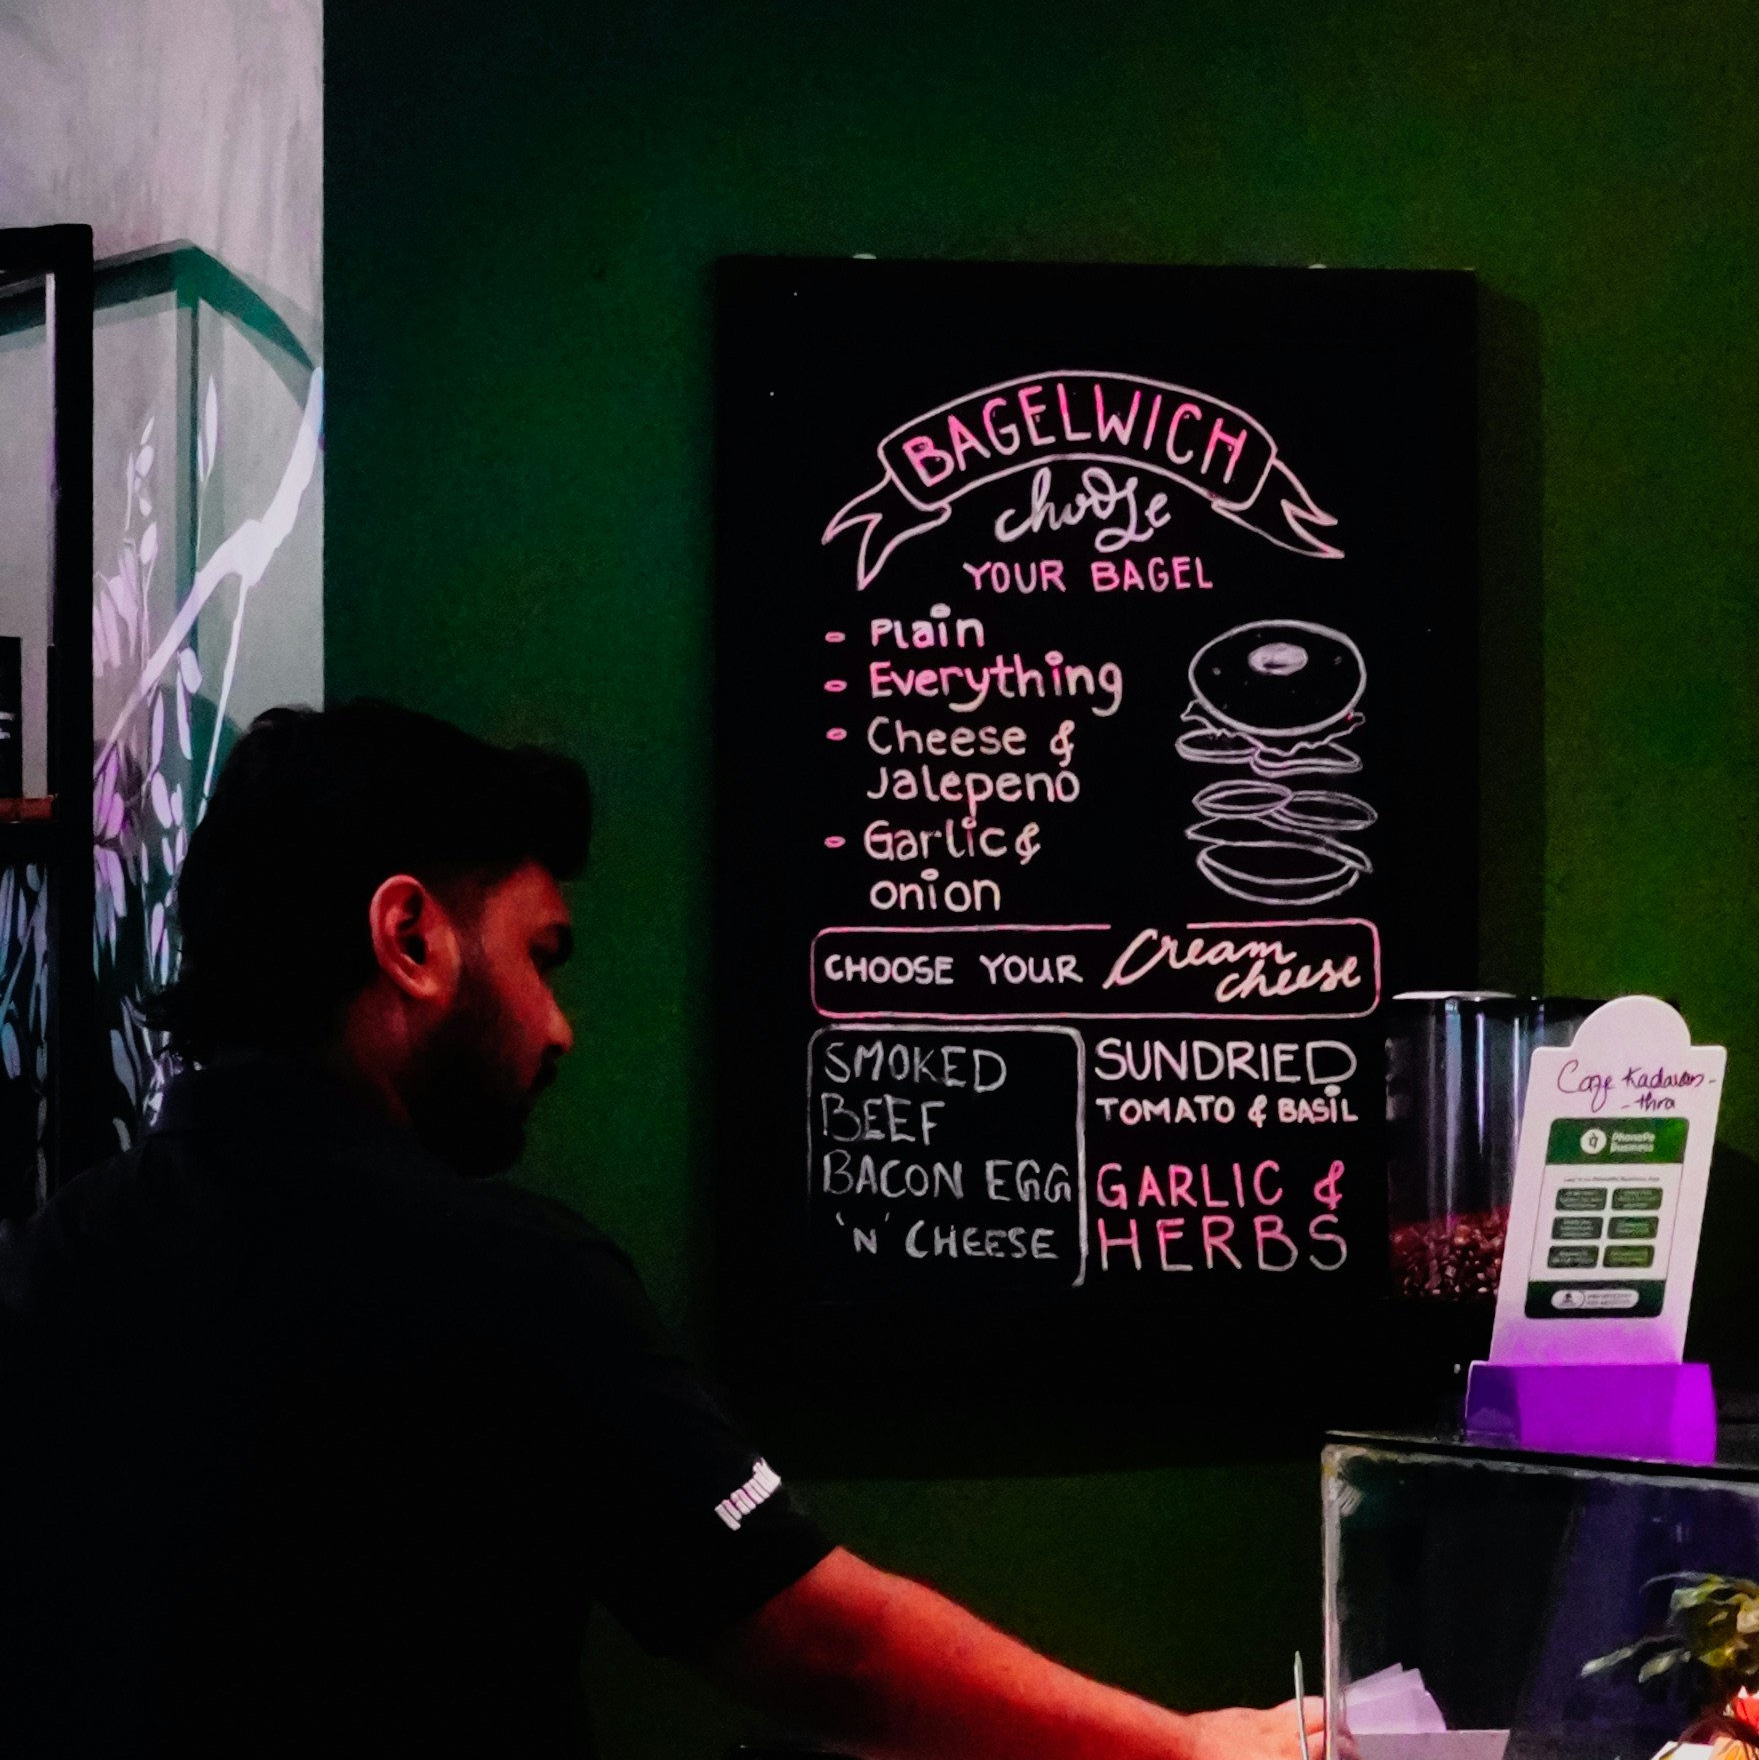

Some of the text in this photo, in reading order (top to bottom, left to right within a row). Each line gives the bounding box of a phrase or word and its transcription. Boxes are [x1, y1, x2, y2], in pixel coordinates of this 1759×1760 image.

[902, 384, 1248, 486] BAGELWICH
[962, 556, 1214, 594] YOUR BAGEL
[870, 603, 985, 649] Plain
[869, 651, 1124, 716] Everything
[867, 716, 1076, 768] Cheese &
[866, 767, 1081, 815] Jalepeno
[863, 816, 1042, 866] Garlic &
[869, 867, 1001, 913] onion
[824, 927, 1297, 990] CHOOSE YOUR Cream
[823, 1041, 1008, 1093] SMOKED
[1094, 1038, 1357, 1086] SUNDRIED
[820, 1093, 946, 1145] BEEF
[1095, 1095, 1236, 1126] TOMATO
[1247, 1093, 1268, 1129] &
[823, 1149, 1073, 1203] BACON EGG
[1096, 1159, 1345, 1211] GARLIC &
[905, 1220, 1059, 1259] CHEESE
[1097, 1214, 1348, 1272] HERBS
